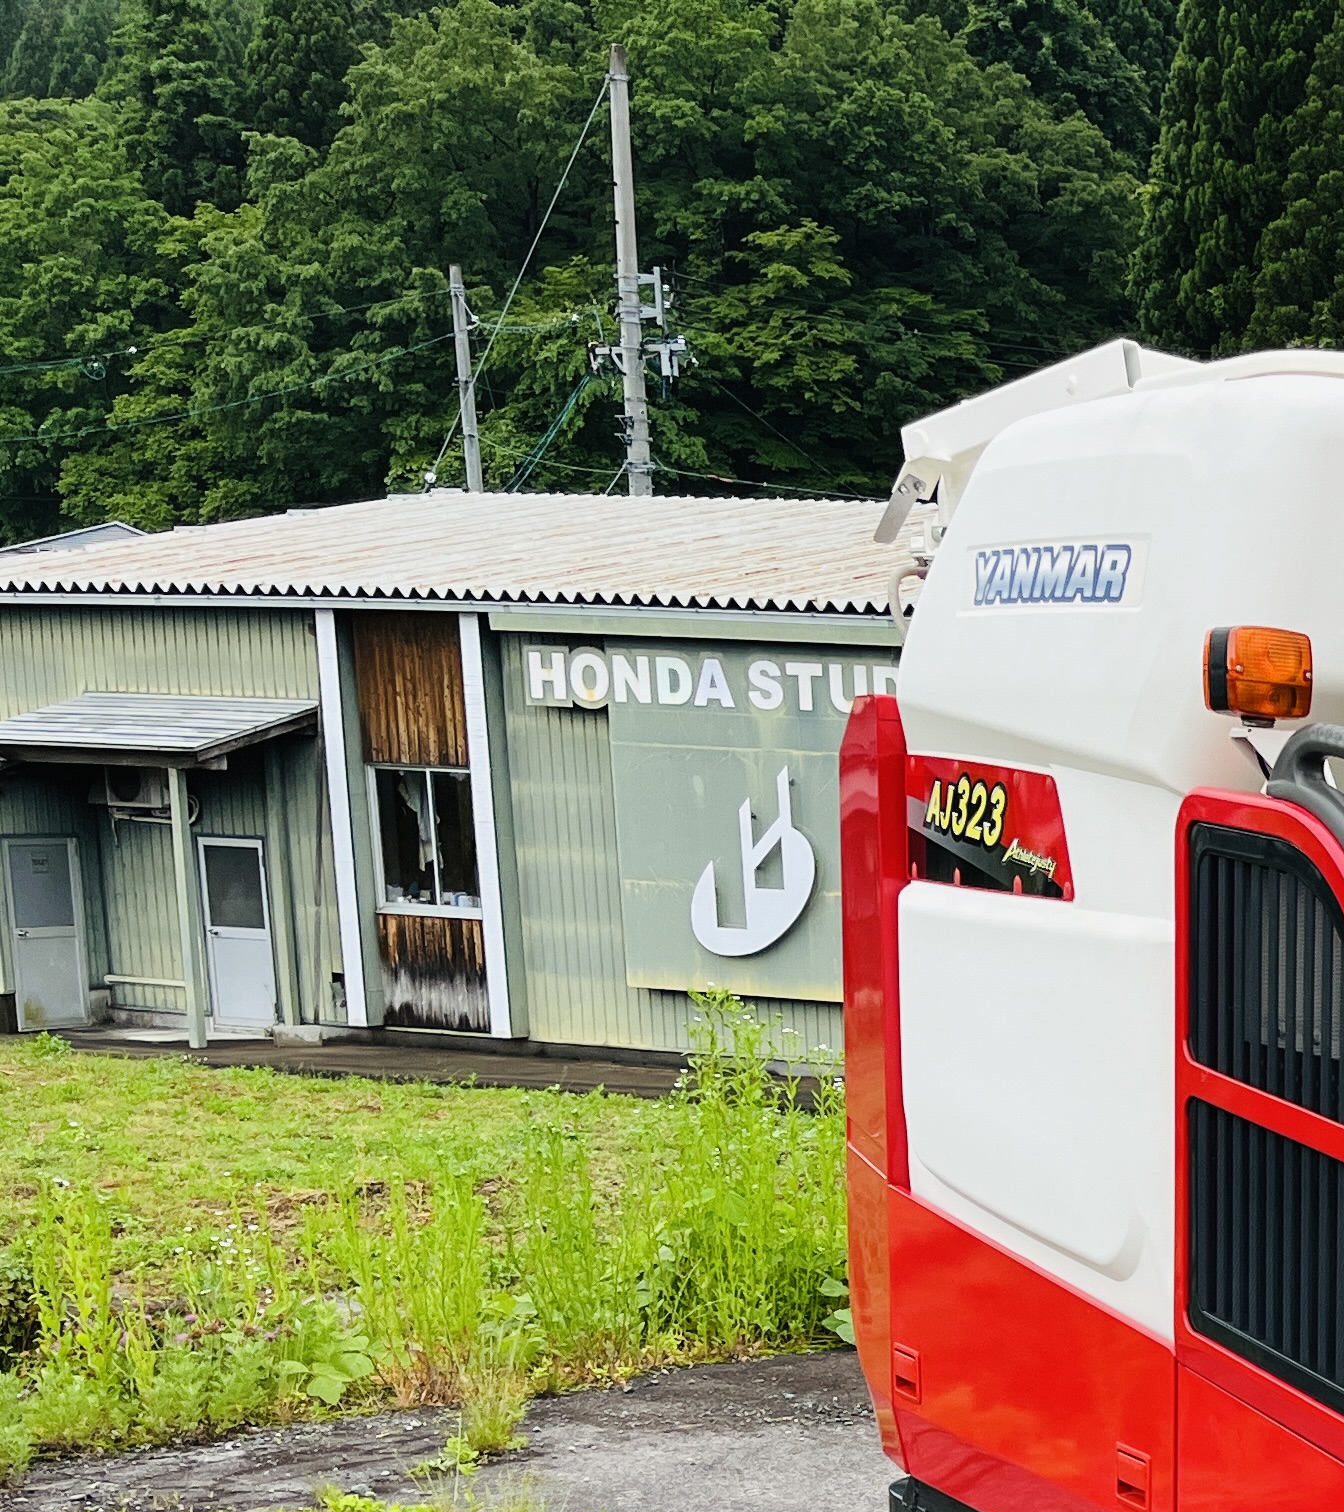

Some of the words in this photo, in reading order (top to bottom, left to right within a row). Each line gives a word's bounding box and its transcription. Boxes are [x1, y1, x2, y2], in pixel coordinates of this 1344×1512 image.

[974, 543, 1132, 606] YANMAR
[527, 651, 736, 709] HONDA
[925, 772, 1007, 849] AJ323
